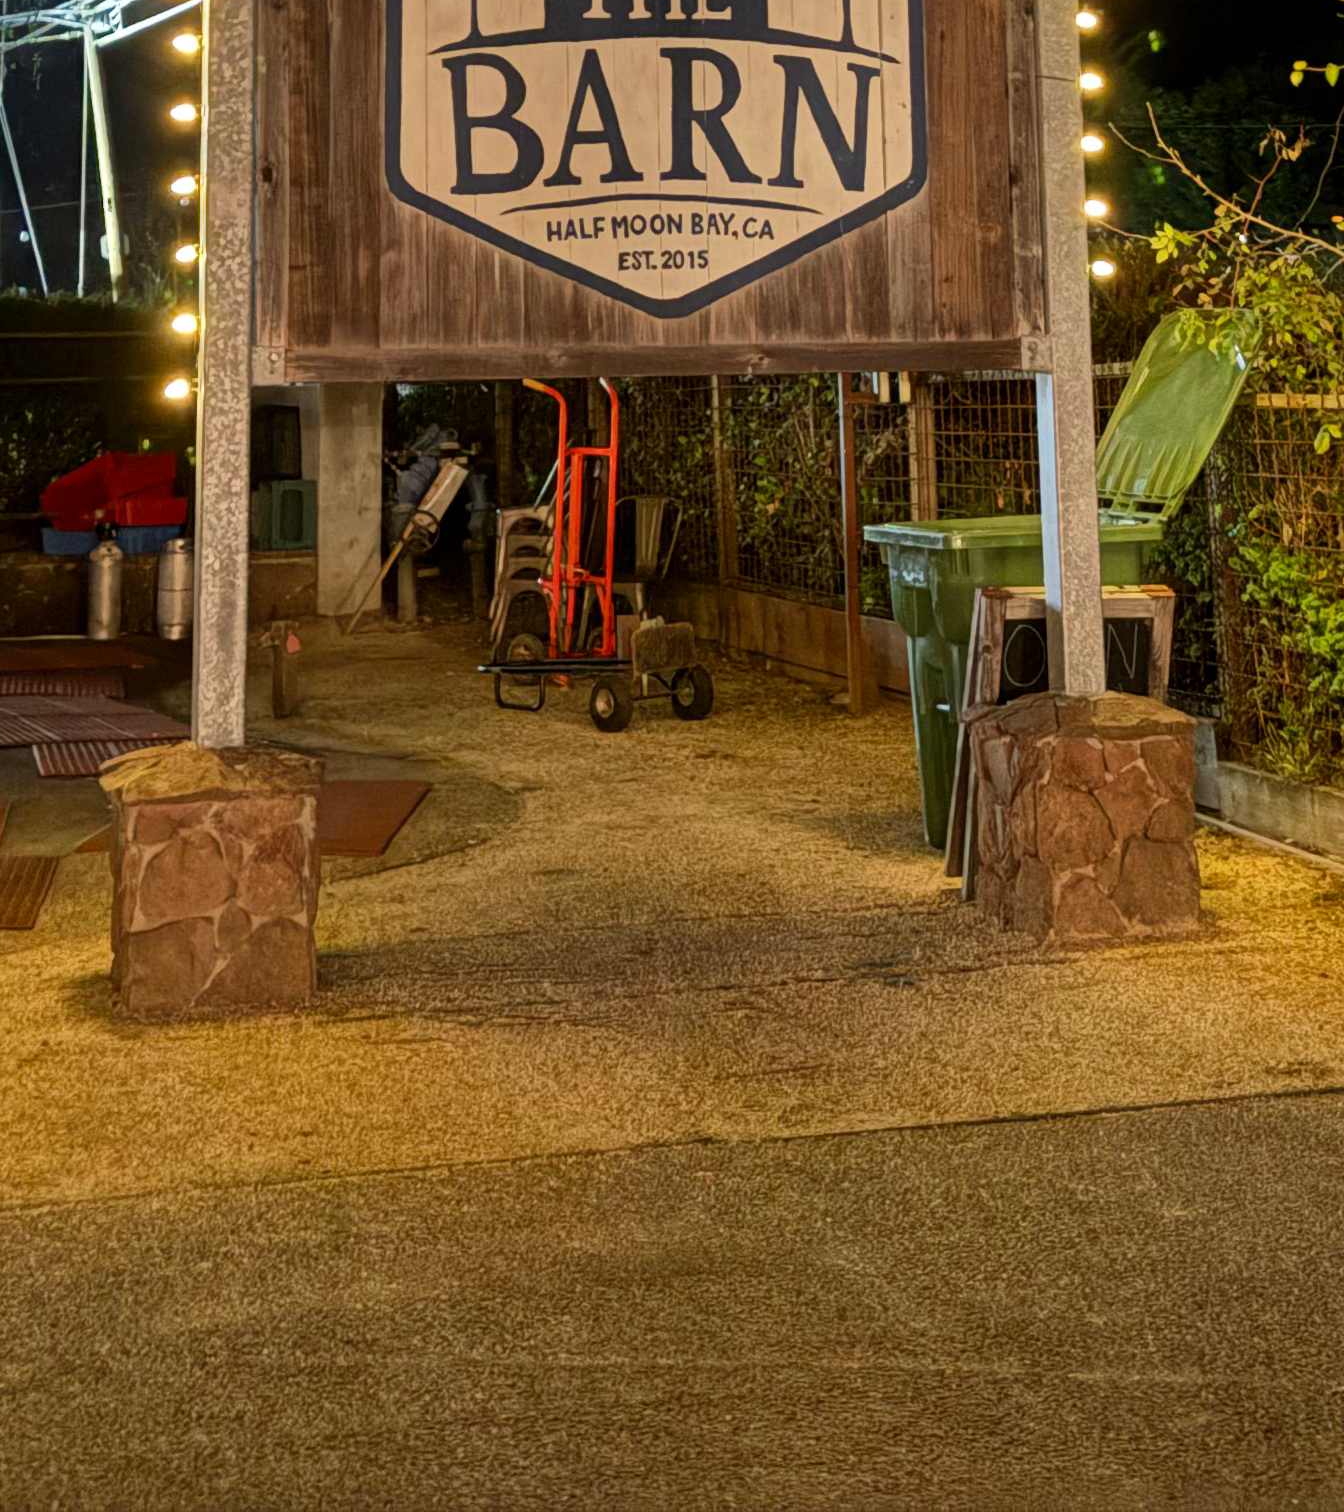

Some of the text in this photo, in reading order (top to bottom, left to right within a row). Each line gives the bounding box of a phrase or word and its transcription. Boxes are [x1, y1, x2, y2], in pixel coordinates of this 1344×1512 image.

[442, 47, 881, 196] BARN
[546, 212, 775, 242] HALF MOON BAY, CA
[617, 249, 709, 271] EST. 2015
